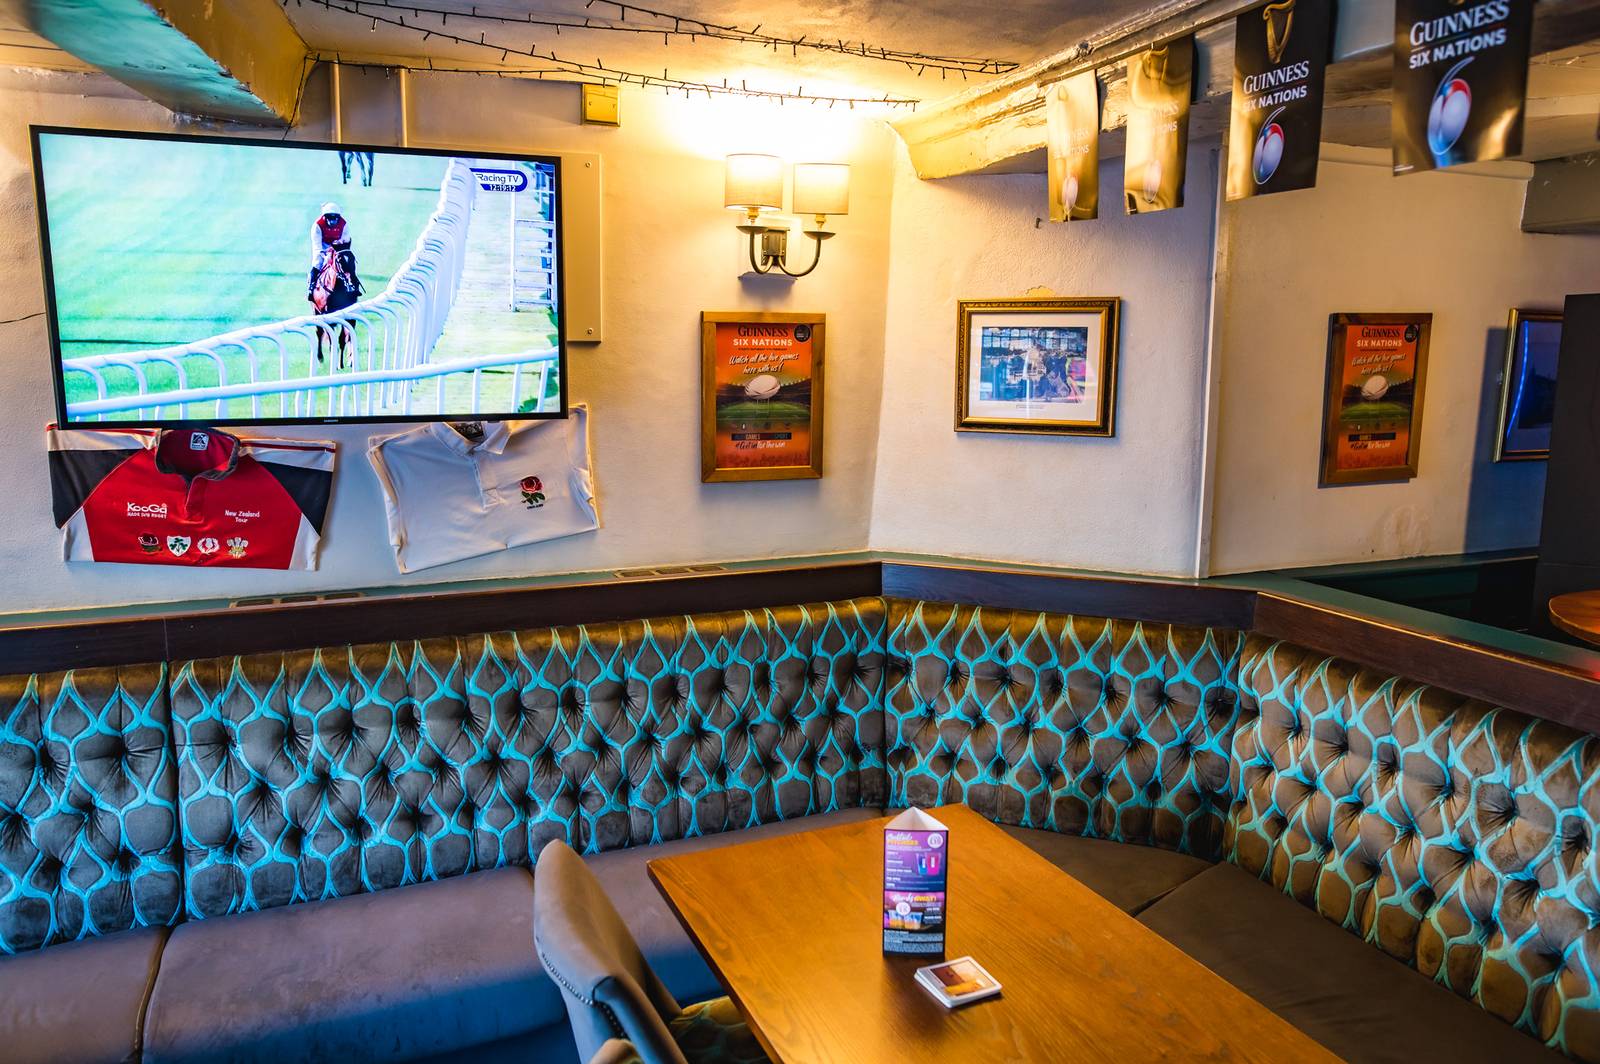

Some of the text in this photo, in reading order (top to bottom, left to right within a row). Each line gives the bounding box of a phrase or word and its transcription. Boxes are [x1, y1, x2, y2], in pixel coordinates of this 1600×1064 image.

[1410, 1, 1509, 46] GUINNESS
[1409, 28, 1507, 69] SIX NATIONS
[1243, 60, 1309, 94] GUINNESS
[1258, 85, 1308, 108] NATIONS
[475, 173, 518, 184] Racing TV
[738, 325, 789, 337] GUINNESS
[1361, 327, 1400, 337] GUINNESS
[733, 338, 793, 346] SIX NATIONS
[1356, 339, 1402, 347] SIX NATIONS
[127, 502, 167, 513] KooGa
[225, 509, 260, 518] New Zealand
